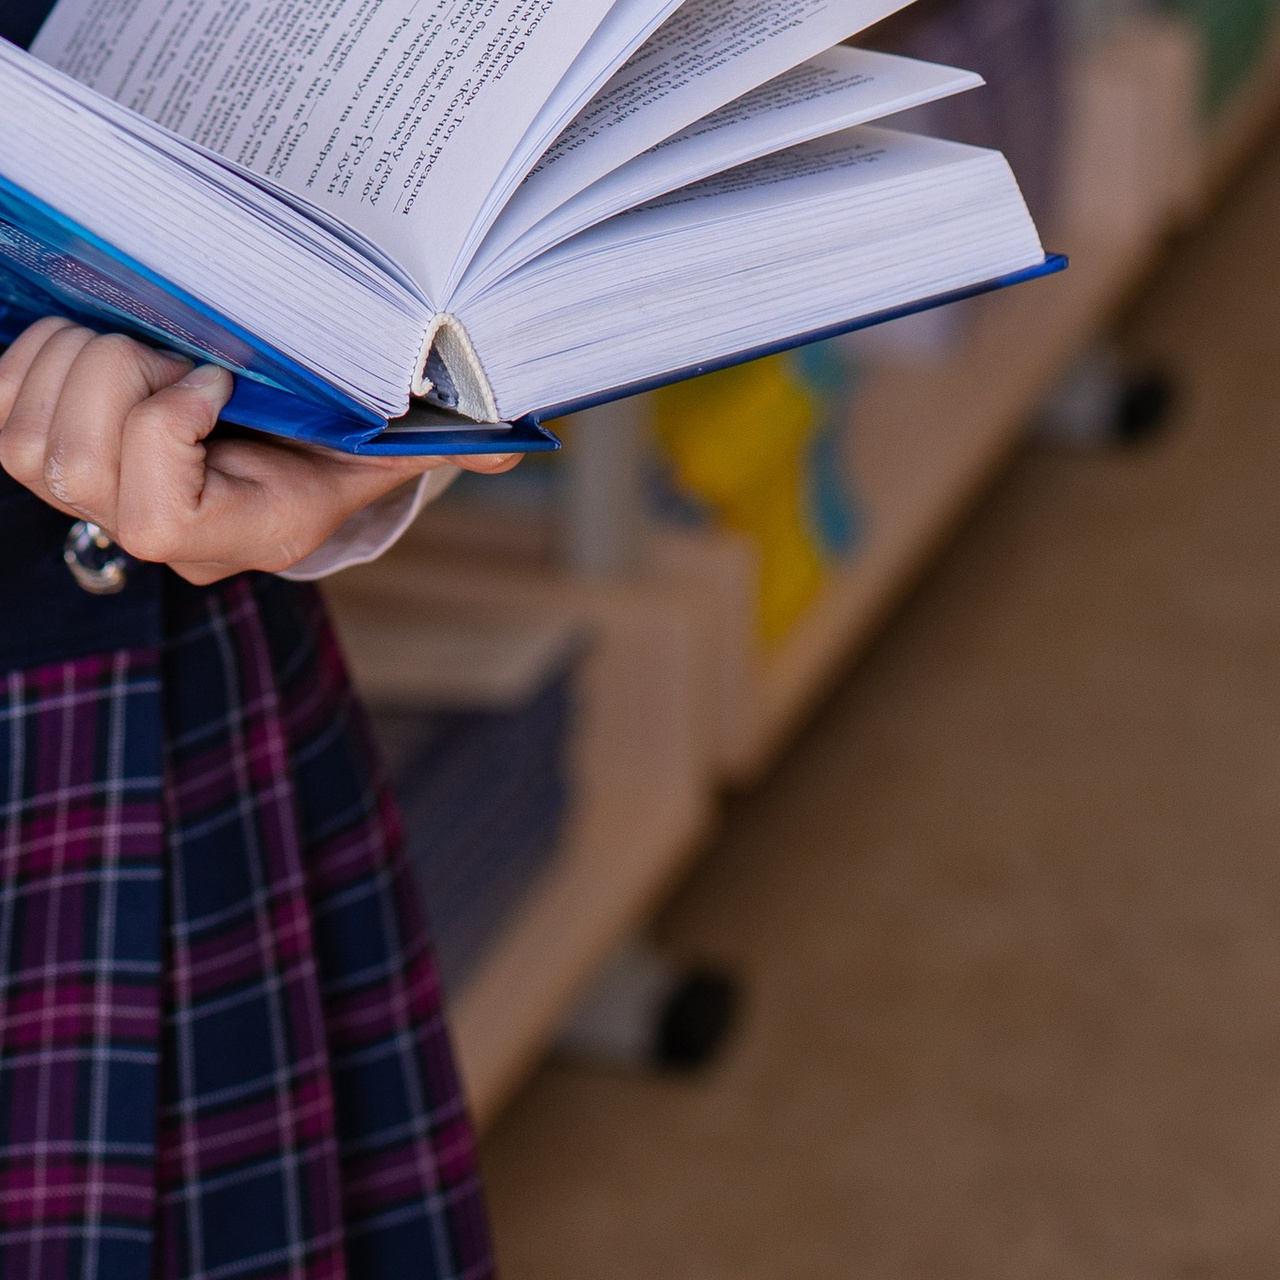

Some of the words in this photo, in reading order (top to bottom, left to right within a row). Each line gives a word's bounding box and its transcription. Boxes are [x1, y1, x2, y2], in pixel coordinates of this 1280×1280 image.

[387, 17, 410, 43] Рон
[402, 23, 442, 78] сказала
[450, 37, 459, 46] с
[452, 20, 486, 60] было,
[472, 27, 507, 73] изрёк:
[319, 33, 348, 72] знает,
[360, 14, 437, 129] нумерологии»!
[461, 24, 520, 109] дневником.
[491, 41, 525, 83] Фред.
[304, 77, 321, 99] мы
[352, 47, 388, 101] кивнул
[434, 65, 454, 90] как
[339, 105, 353, 122] на
[388, 50, 453, 144] Рождеством.
[421, 94, 436, 112] по
[425, 78, 471, 146] «Кончил
[350, 135, 363, 148] И
[392, 115, 422, 162] всему
[442, 115, 465, 142] Тот
[263, 124, 294, 176] можем
[274, 121, 308, 179] Сириус
[305, 126, 340, 188] свёрток
[353, 136, 374, 166] Сто
[374, 150, 391, 172] По
[403, 150, 426, 189] дело
[326, 151, 350, 193] духи
[338, 169, 354, 197] лет
[360, 176, 375, 202] до-
[369, 164, 393, 206] дому
[402, 146, 443, 215] врезался
